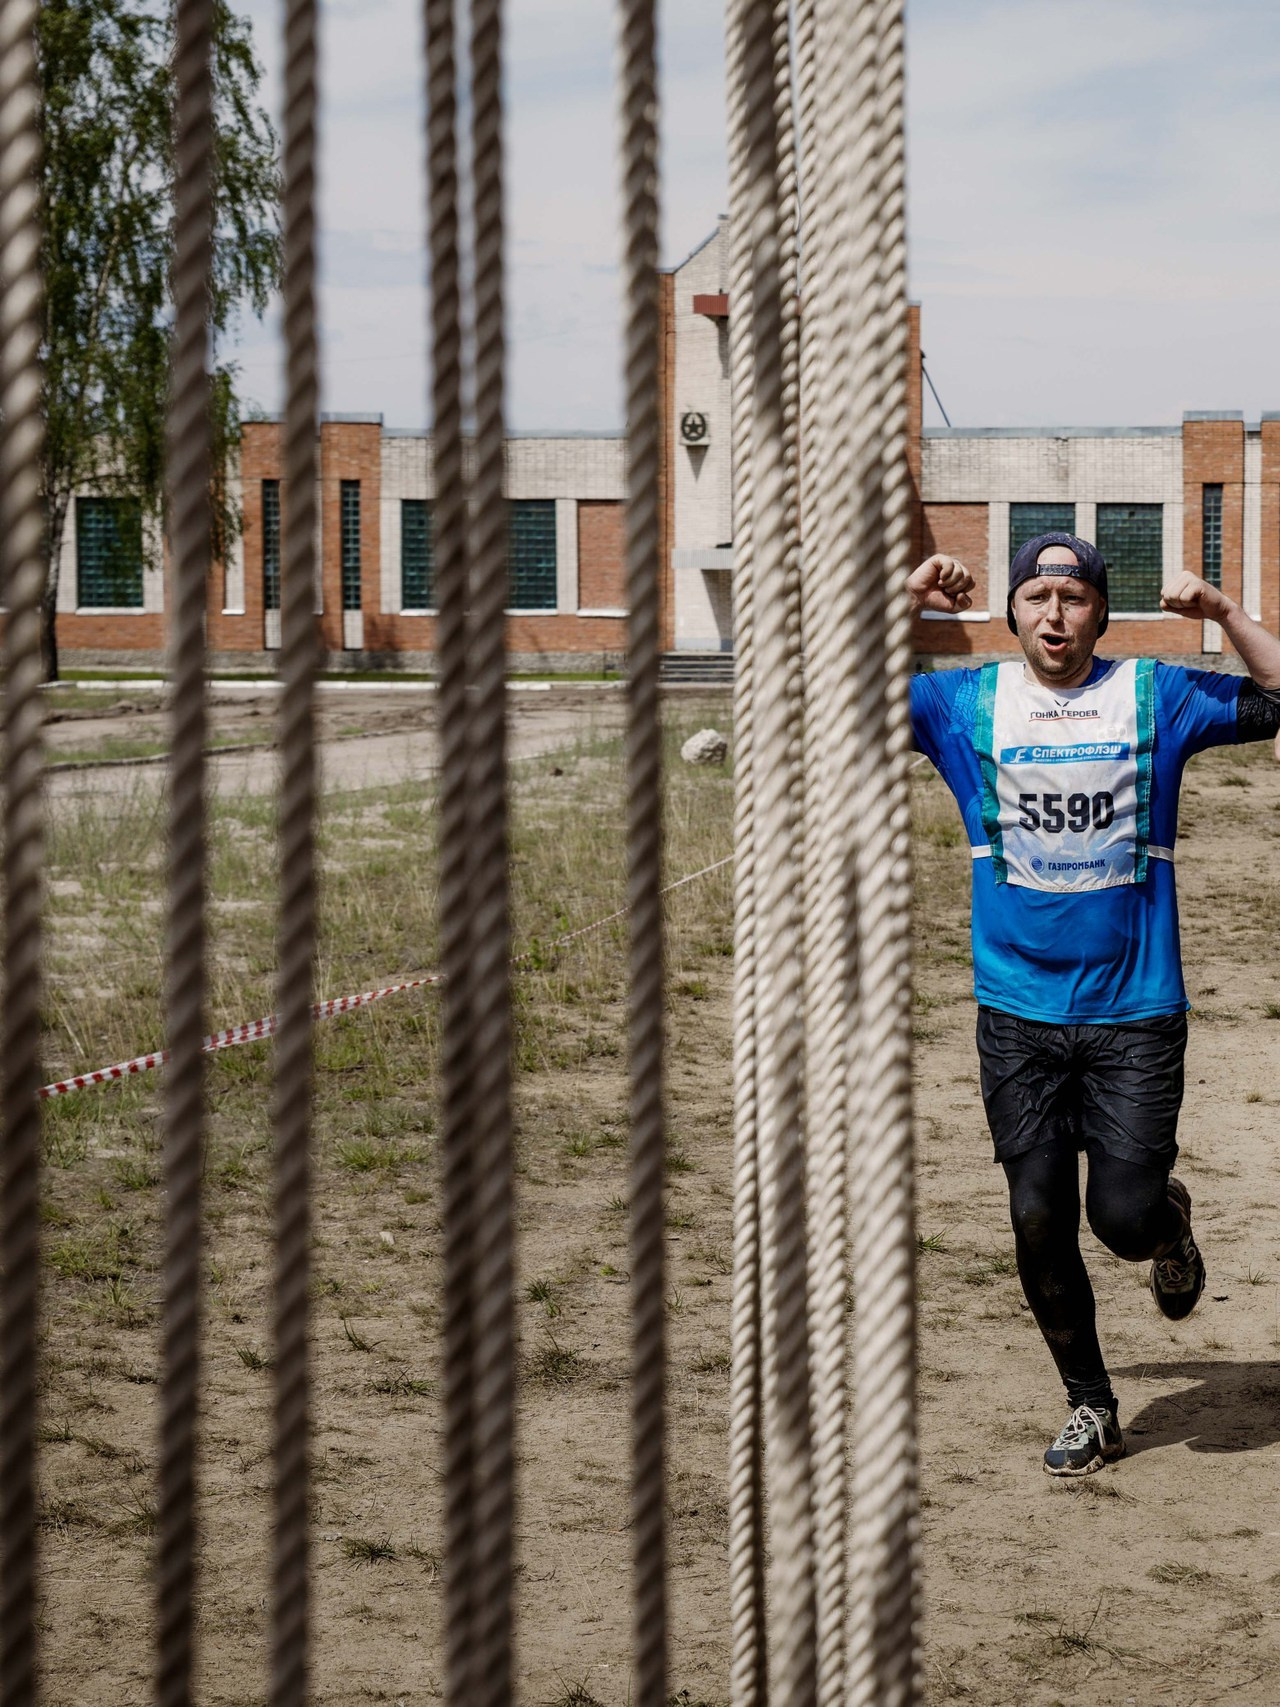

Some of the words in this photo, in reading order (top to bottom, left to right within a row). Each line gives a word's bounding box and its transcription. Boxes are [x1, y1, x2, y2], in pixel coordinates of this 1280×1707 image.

[1030, 709, 1059, 720] ГОНКА
[1061, 708, 1099, 718] ГЕРОЕВ
[1032, 744, 1122, 758] СПЕКТРОФЛЭШ
[1019, 791, 1115, 833] 5590
[1048, 857, 1106, 871] ГАЗПРОМБАНК
